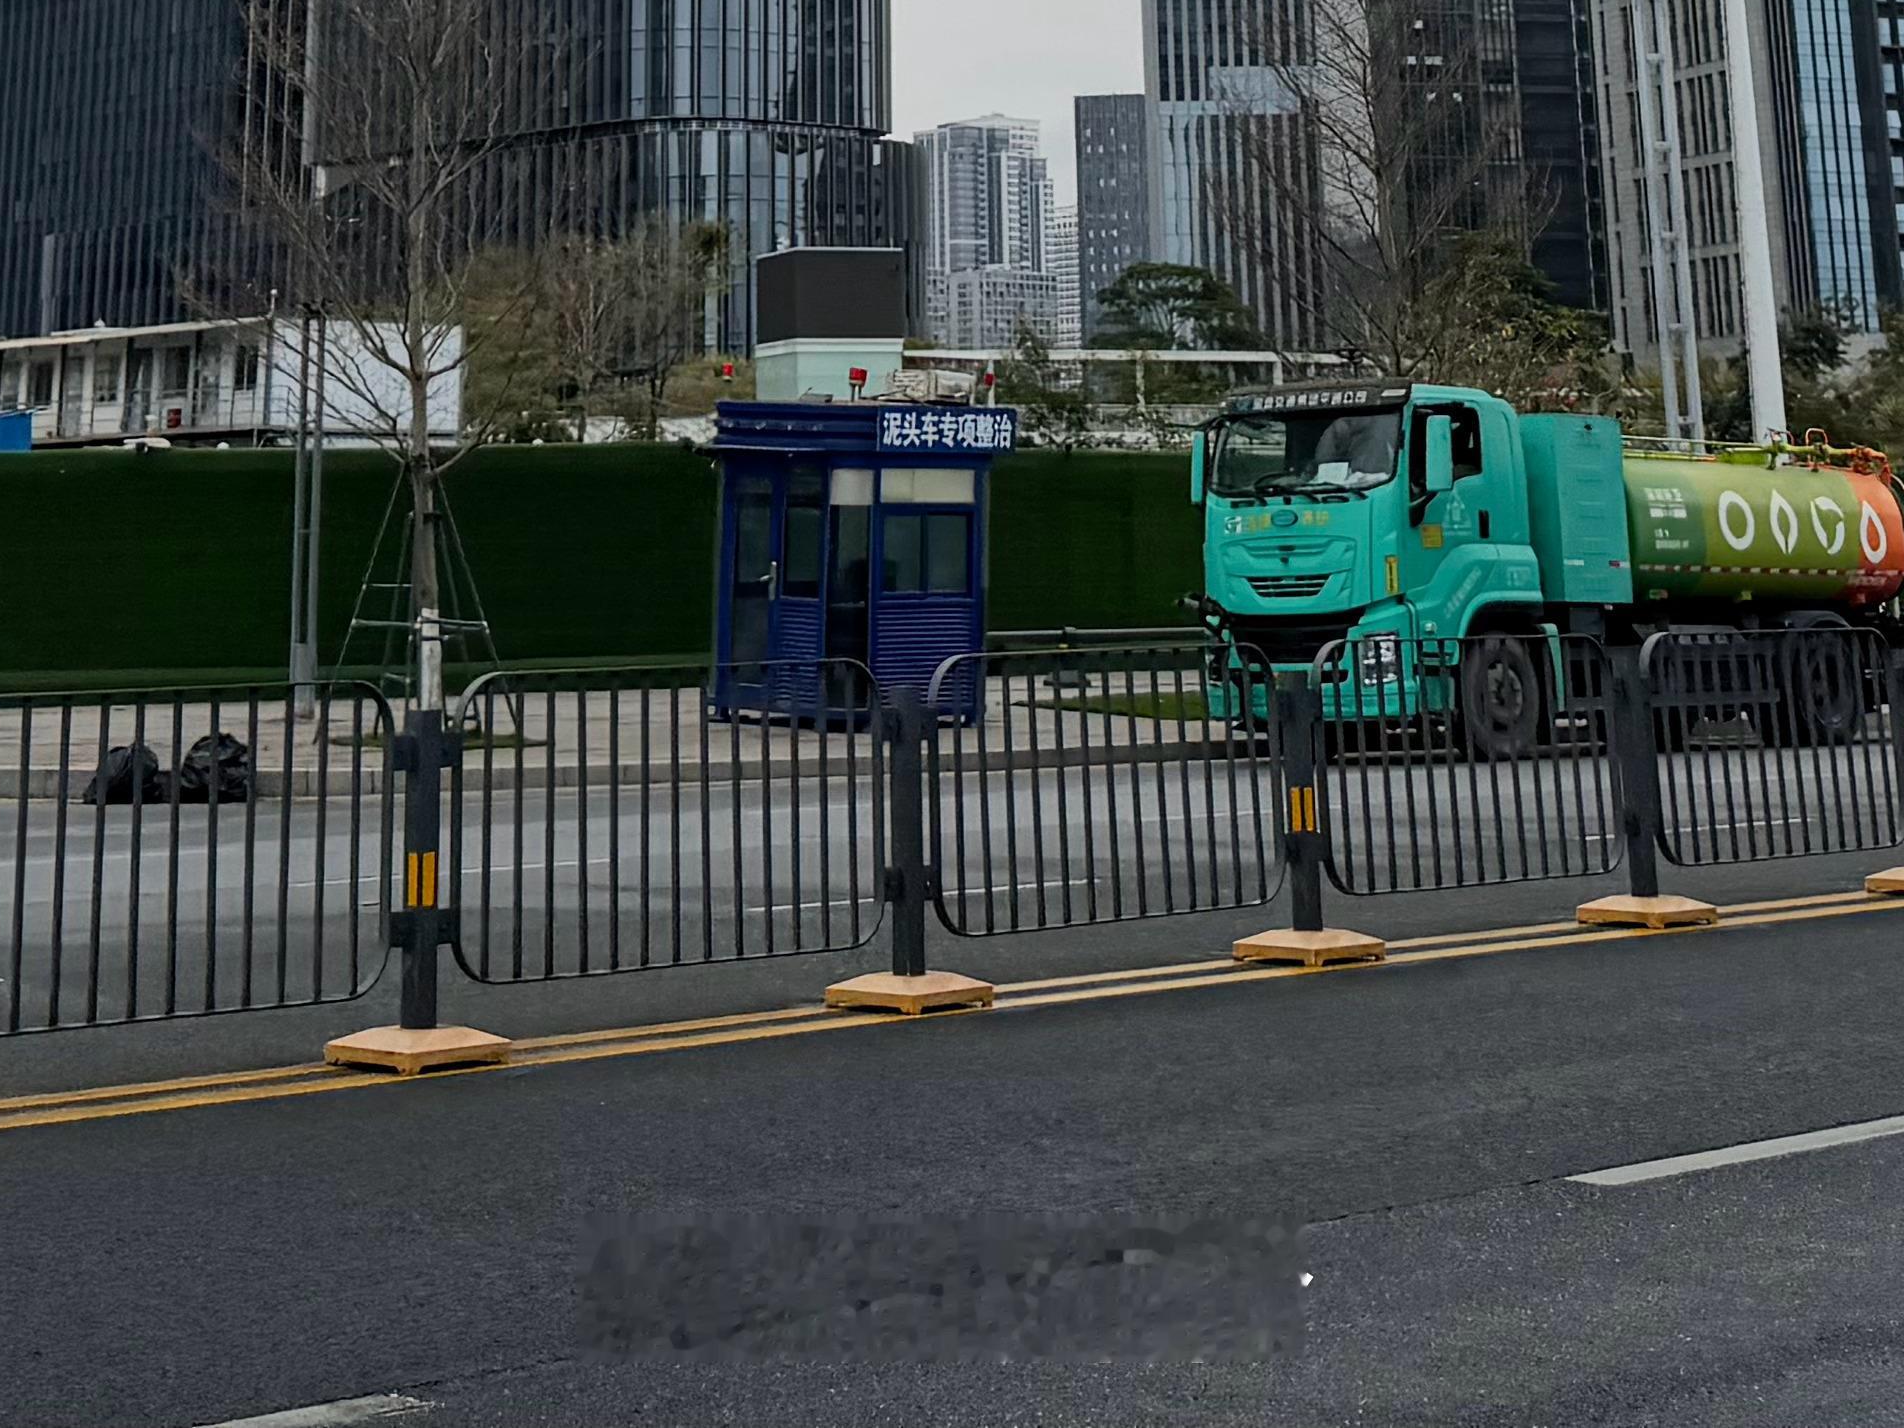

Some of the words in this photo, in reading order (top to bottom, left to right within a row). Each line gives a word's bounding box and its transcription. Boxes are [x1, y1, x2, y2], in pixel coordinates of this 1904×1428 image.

[882, 411, 1013, 449] 泥头车专项整治
